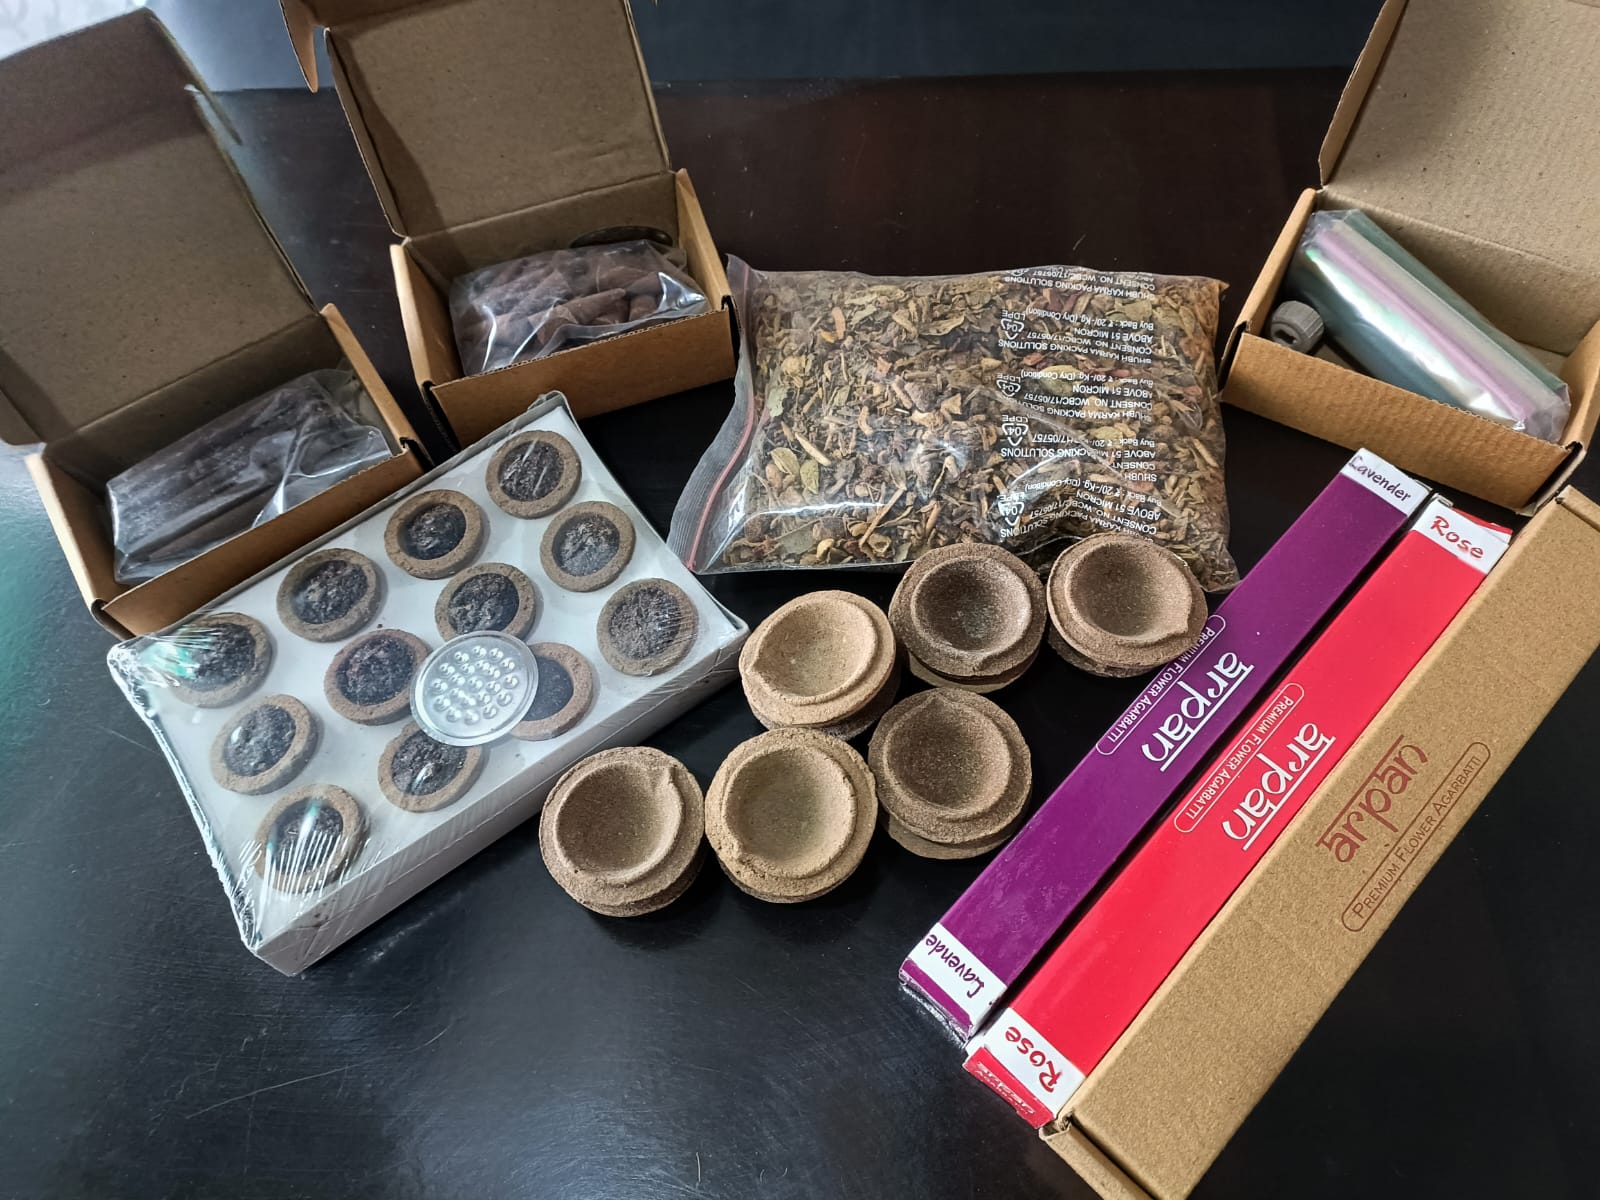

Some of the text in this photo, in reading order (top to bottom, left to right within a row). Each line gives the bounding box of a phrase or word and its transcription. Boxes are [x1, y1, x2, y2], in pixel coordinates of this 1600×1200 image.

[1004, 276, 1053, 288] SOLUTIONS
[1055, 280, 1093, 292] PACKING
[1093, 285, 1124, 297] KARMA
[1001, 310, 1025, 320] LDPE
[1026, 306, 1061, 322] Condition)
[1062, 311, 1079, 324] (Dry
[1139, 322, 1153, 330] Buy
[1074, 327, 1153, 343] ABOVE 51 MICRON
[998, 340, 1048, 350] SOLUTIONS
[1050, 343, 1088, 354] PACKING
[1111, 342, 1152, 354] CONSENT
[1090, 348, 1119, 359] KARMA
[1020, 370, 1058, 379] Condition)
[1059, 371, 1076, 380] (Dry
[1072, 384, 1110, 394] MICRON
[1110, 400, 1152, 410] CONSENT
[1047, 407, 1086, 418] PACKING
[1088, 410, 1120, 418] KARMA
[1008, 427, 1022, 435] 04
[1140, 439, 1155, 448] Buy
[1001, 448, 1055, 457] SOLUTIONS
[1056, 448, 1091, 457] ACKING
[1124, 450, 1156, 458] ABOVE
[1111, 461, 1156, 470] CONSENT
[1124, 472, 1157, 481] SHUBH
[1348, 455, 1412, 502] Lavender
[1076, 490, 1161, 521] ABOVE 51 MICRON
[1000, 510, 1121, 537] KARMA PACKING SOLUTIONS
[1111, 516, 1157, 534] CONSENT
[1430, 515, 1485, 559] Rose
[1147, 663, 1184, 697] FLOWER
[1141, 652, 1251, 767] arpan
[1107, 695, 1152, 743] AGARBATTI
[1185, 695, 1295, 820] PREMIUM FLOWER AGARBATTI
[1222, 723, 1333, 847] arpan
[1315, 735, 1428, 863] arpan
[1351, 755, 1481, 919] PREMIUM FLOWER AGARBATTI
[1004, 1026, 1063, 1093] Rose
